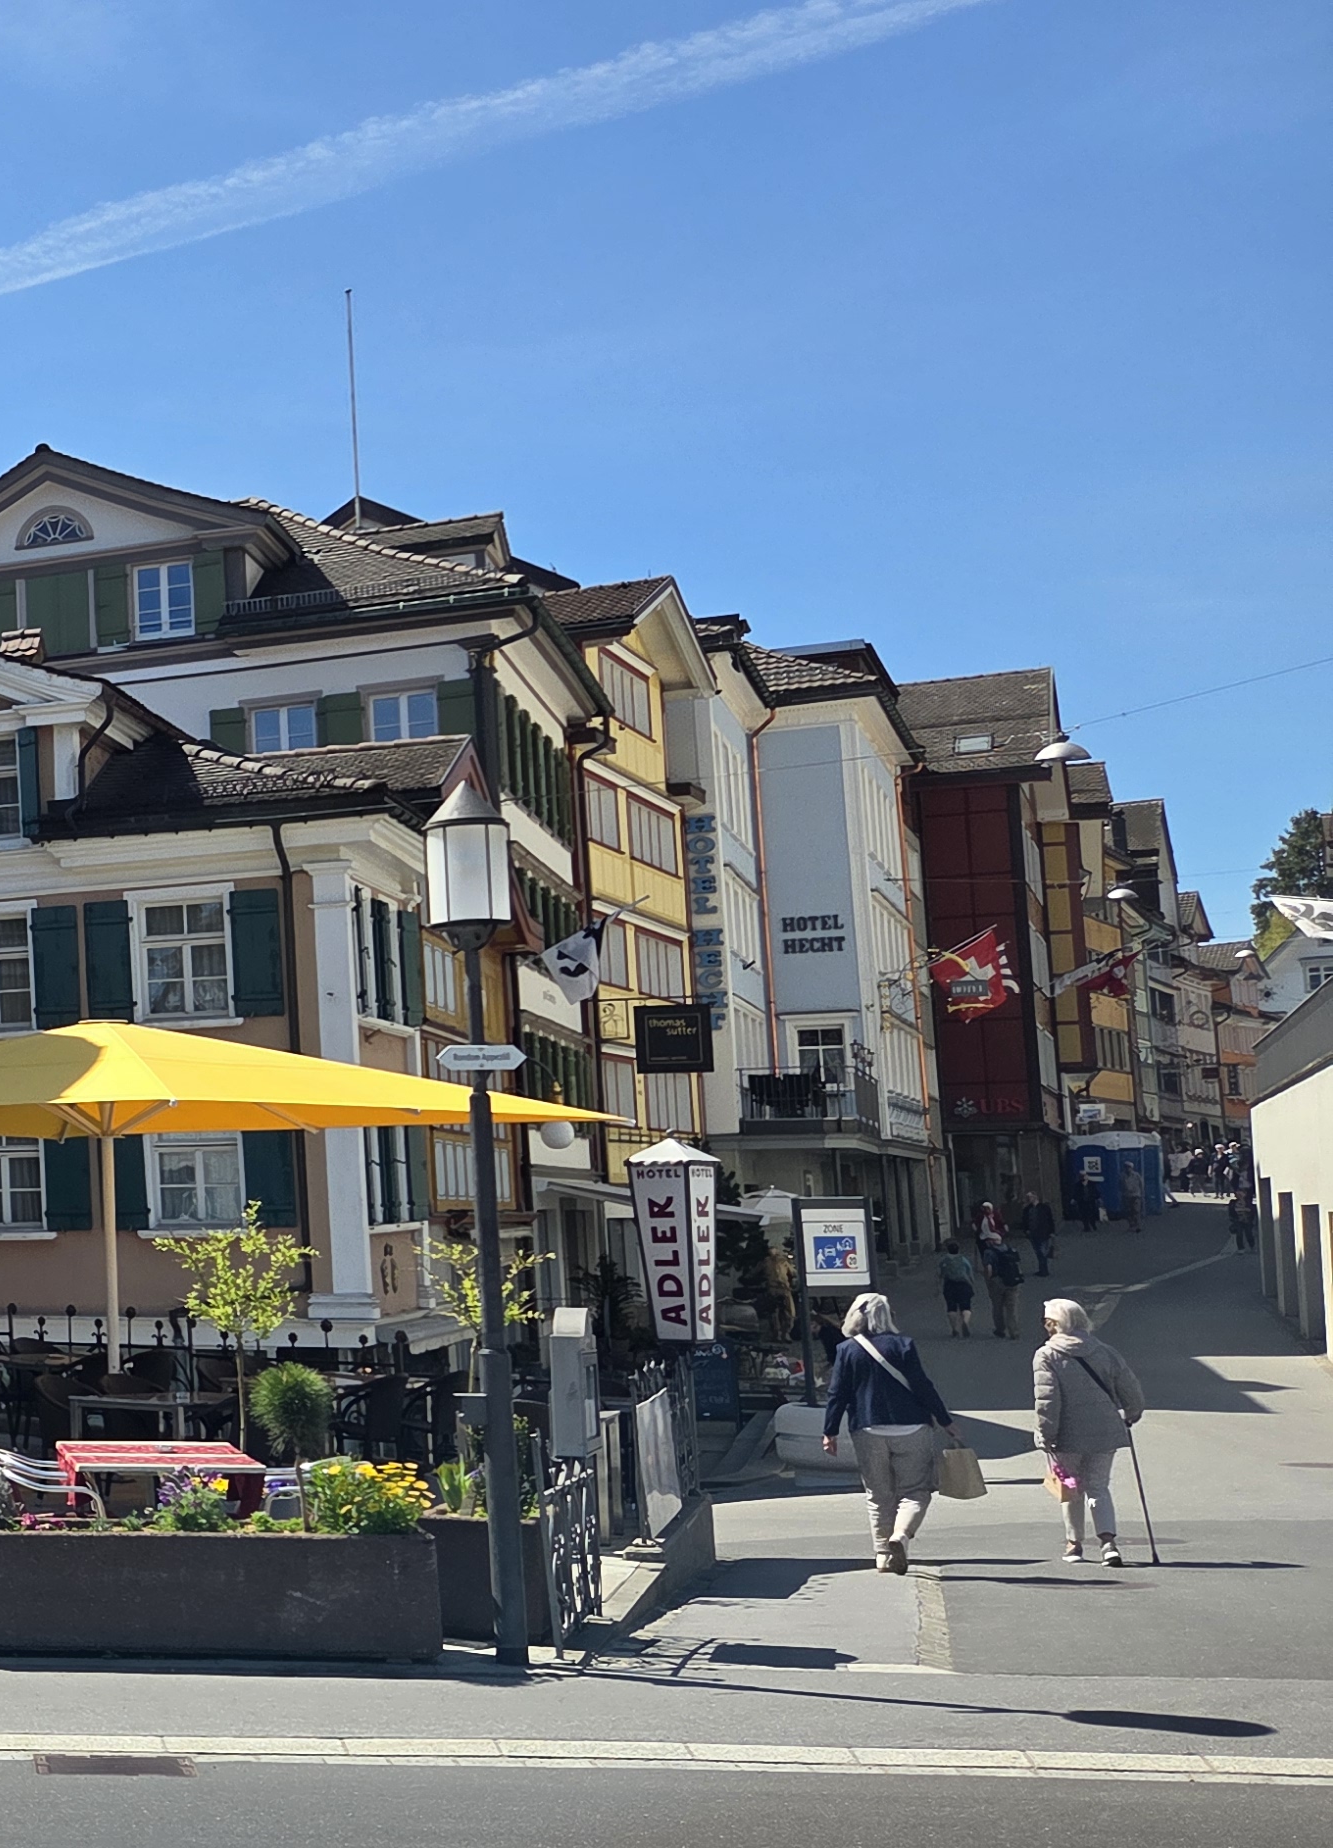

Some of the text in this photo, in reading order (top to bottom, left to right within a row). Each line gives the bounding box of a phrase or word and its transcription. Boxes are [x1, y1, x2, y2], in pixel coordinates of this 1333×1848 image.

[687, 815, 718, 914] HOTEL
[782, 914, 844, 933] HOTEL
[782, 936, 846, 954] HECHT
[648, 1018, 686, 1028] thomas
[666, 1027, 697, 1036] sutter
[979, 1098, 1025, 1114] UBS
[636, 1168, 682, 1180] HOTEL
[691, 1167, 713, 1179] HOTEL
[822, 1224, 844, 1234] ZONE
[647, 1195, 688, 1327] ADLER
[695, 1195, 712, 1326] ADLER
